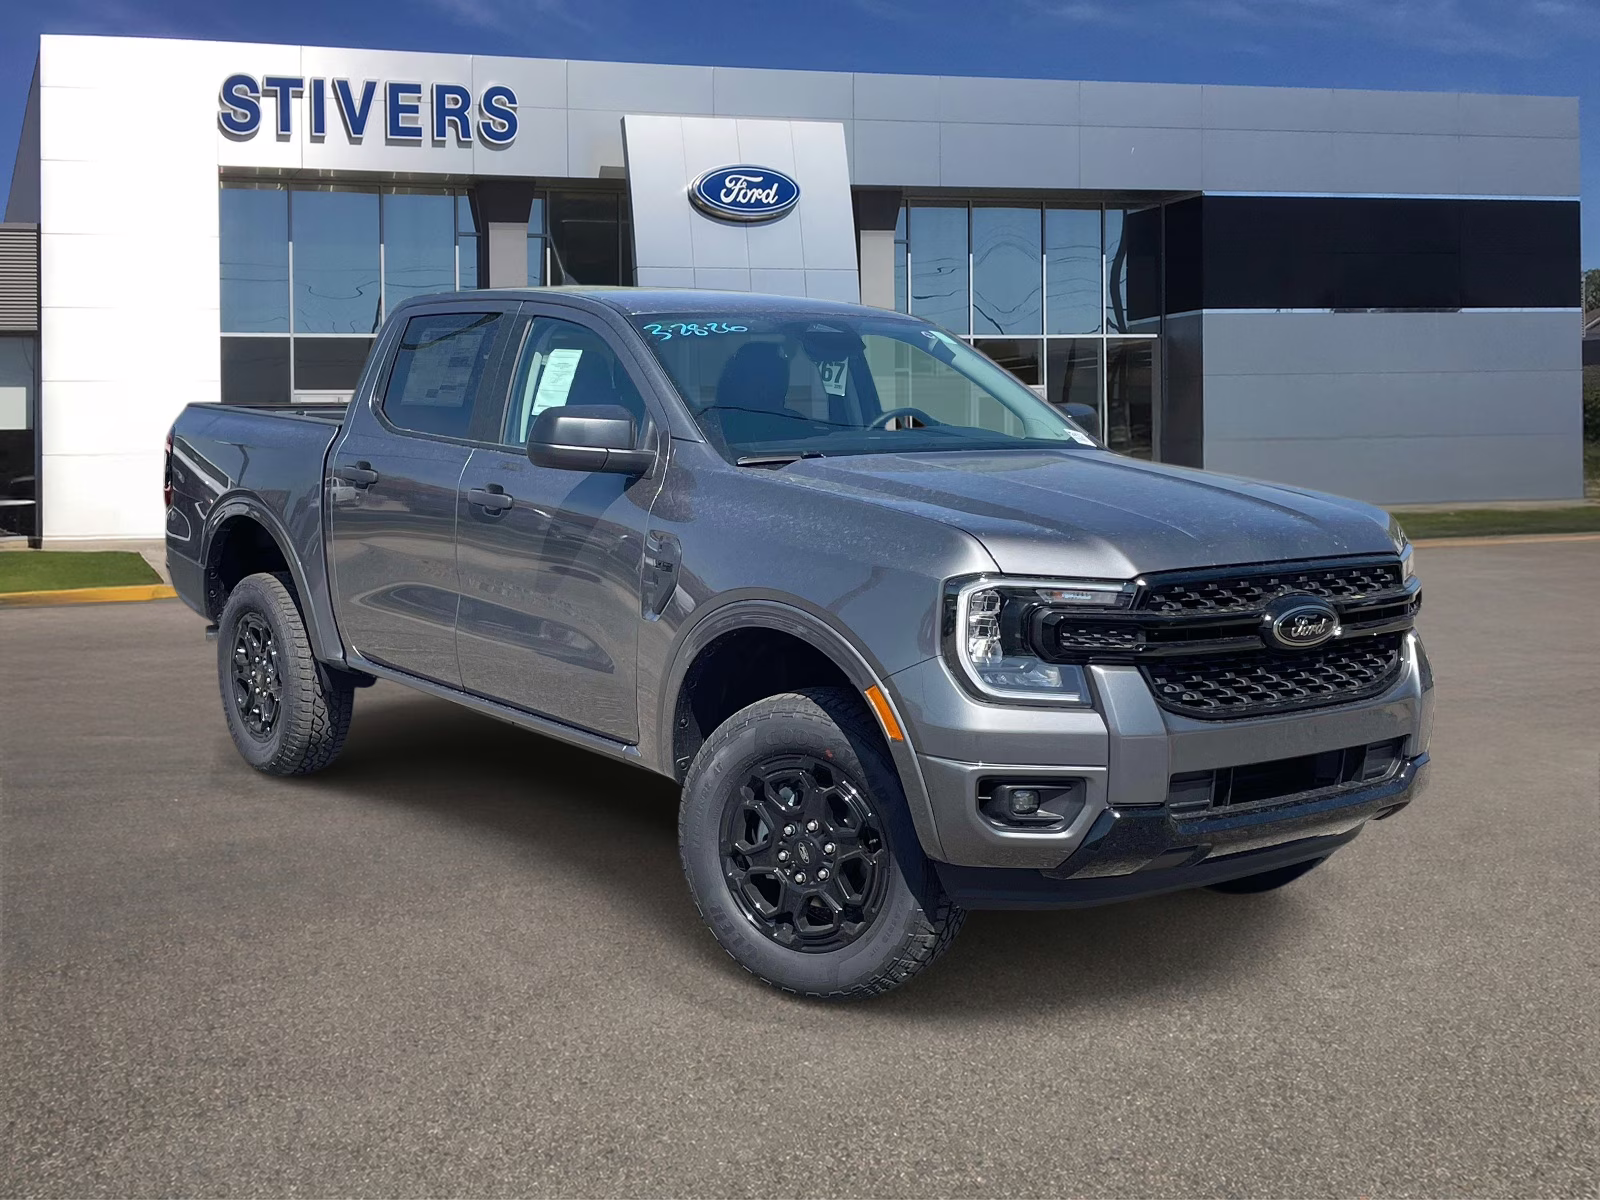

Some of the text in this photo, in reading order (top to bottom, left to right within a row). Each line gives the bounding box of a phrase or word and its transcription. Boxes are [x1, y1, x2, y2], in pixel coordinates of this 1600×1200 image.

[218, 73, 518, 146] STIVERS
[720, 174, 779, 204] Ford
[1291, 614, 1327, 638] Ford
